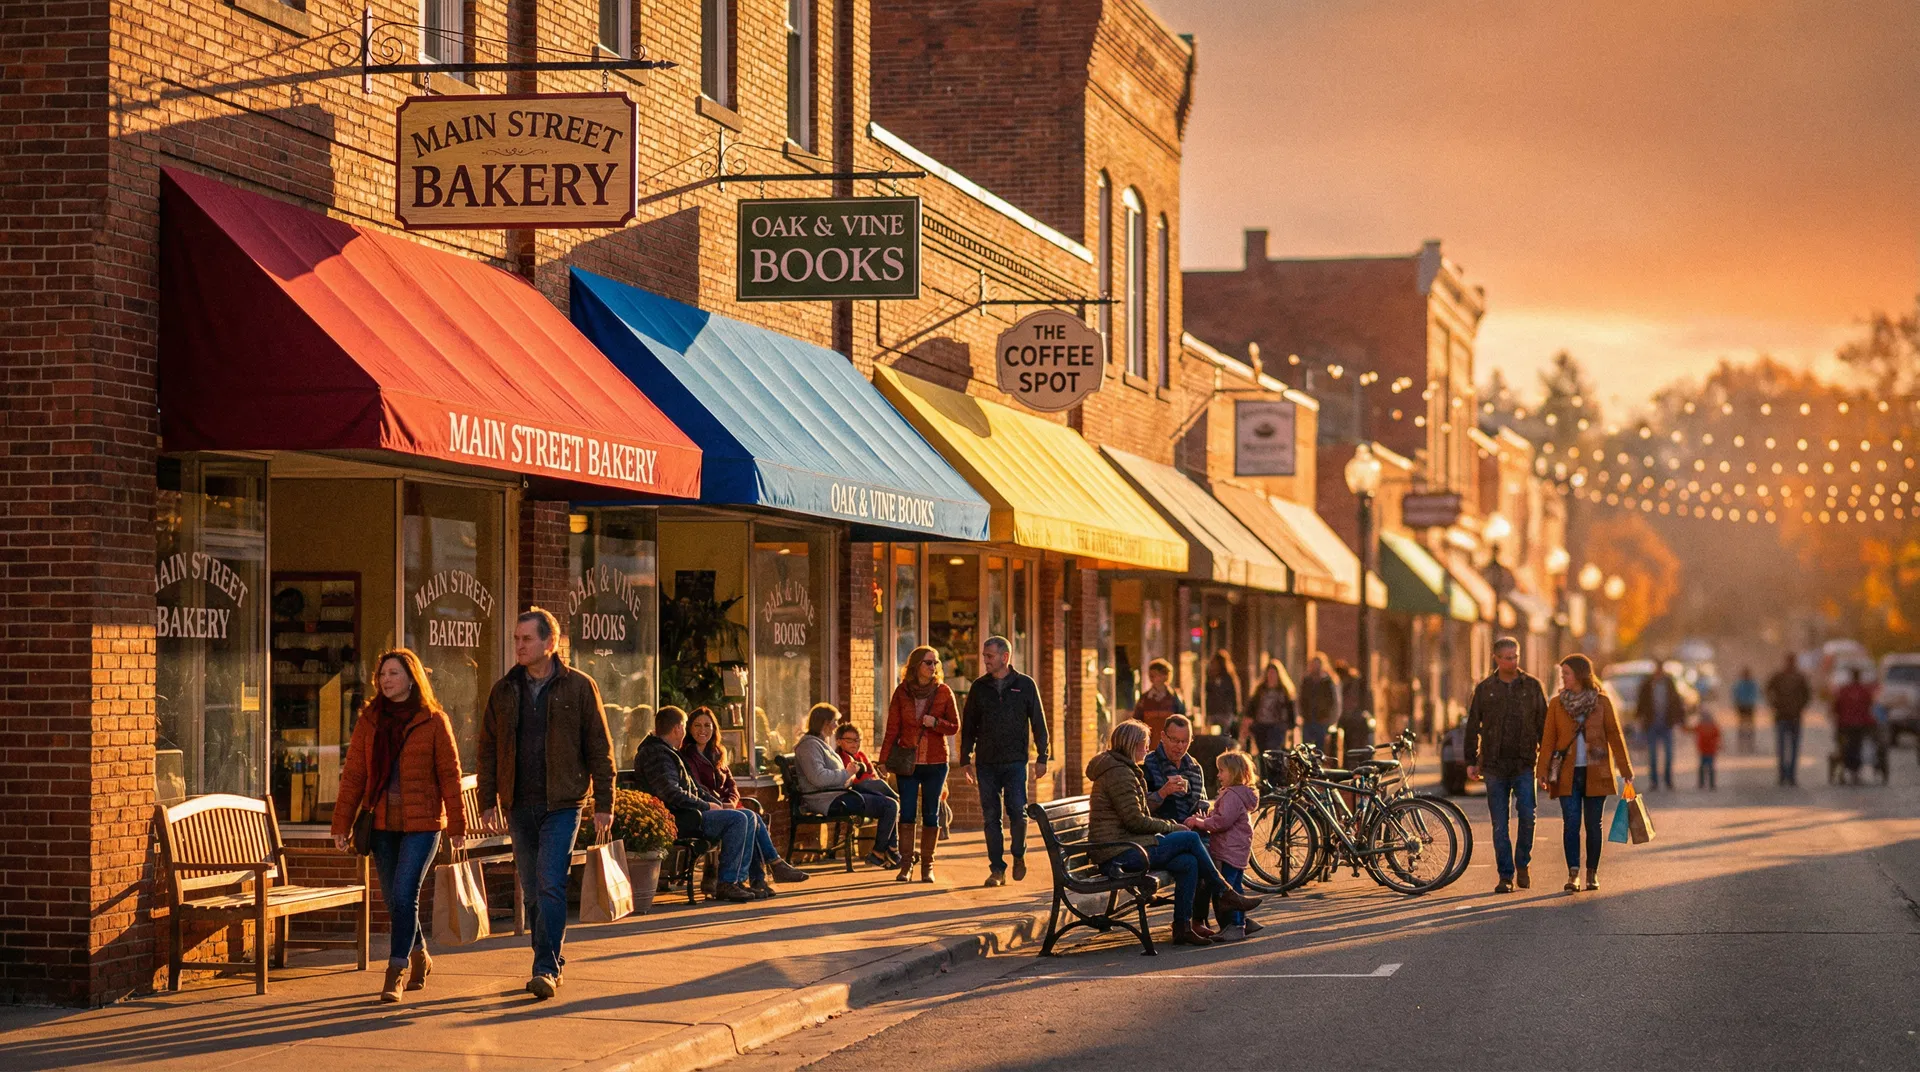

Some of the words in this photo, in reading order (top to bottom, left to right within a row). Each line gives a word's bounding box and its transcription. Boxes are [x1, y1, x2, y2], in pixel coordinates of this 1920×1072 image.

[411, 112, 496, 158] MAIN
[508, 110, 623, 154] STREET
[411, 162, 619, 208] BAKERY
[751, 216, 808, 238] OAK
[813, 215, 835, 237] &
[840, 214, 905, 237] VINE
[750, 246, 905, 283] BOOKS
[1033, 325, 1066, 340] THE
[1004, 345, 1094, 367] COFFEE
[1019, 371, 1080, 393] SPOT
[449, 412, 506, 461] MAIN
[511, 424, 583, 473] STREET
[587, 438, 657, 485] BAKERY
[831, 482, 857, 516] OAK
[859, 487, 868, 518] &
[870, 489, 896, 522] VINE
[898, 495, 935, 528] BOOKS
[191, 551, 248, 608] STREET
[414, 570, 448, 616] MAIN
[450, 569, 495, 618] STREET
[568, 567, 596, 616] OAK
[600, 564, 610, 592] &
[614, 568, 641, 621] VINE
[156, 606, 230, 639] BAKERY
[429, 619, 482, 648] BAKERY
[582, 613, 626, 641] BOOKS
[774, 622, 806, 646] BOOKS
